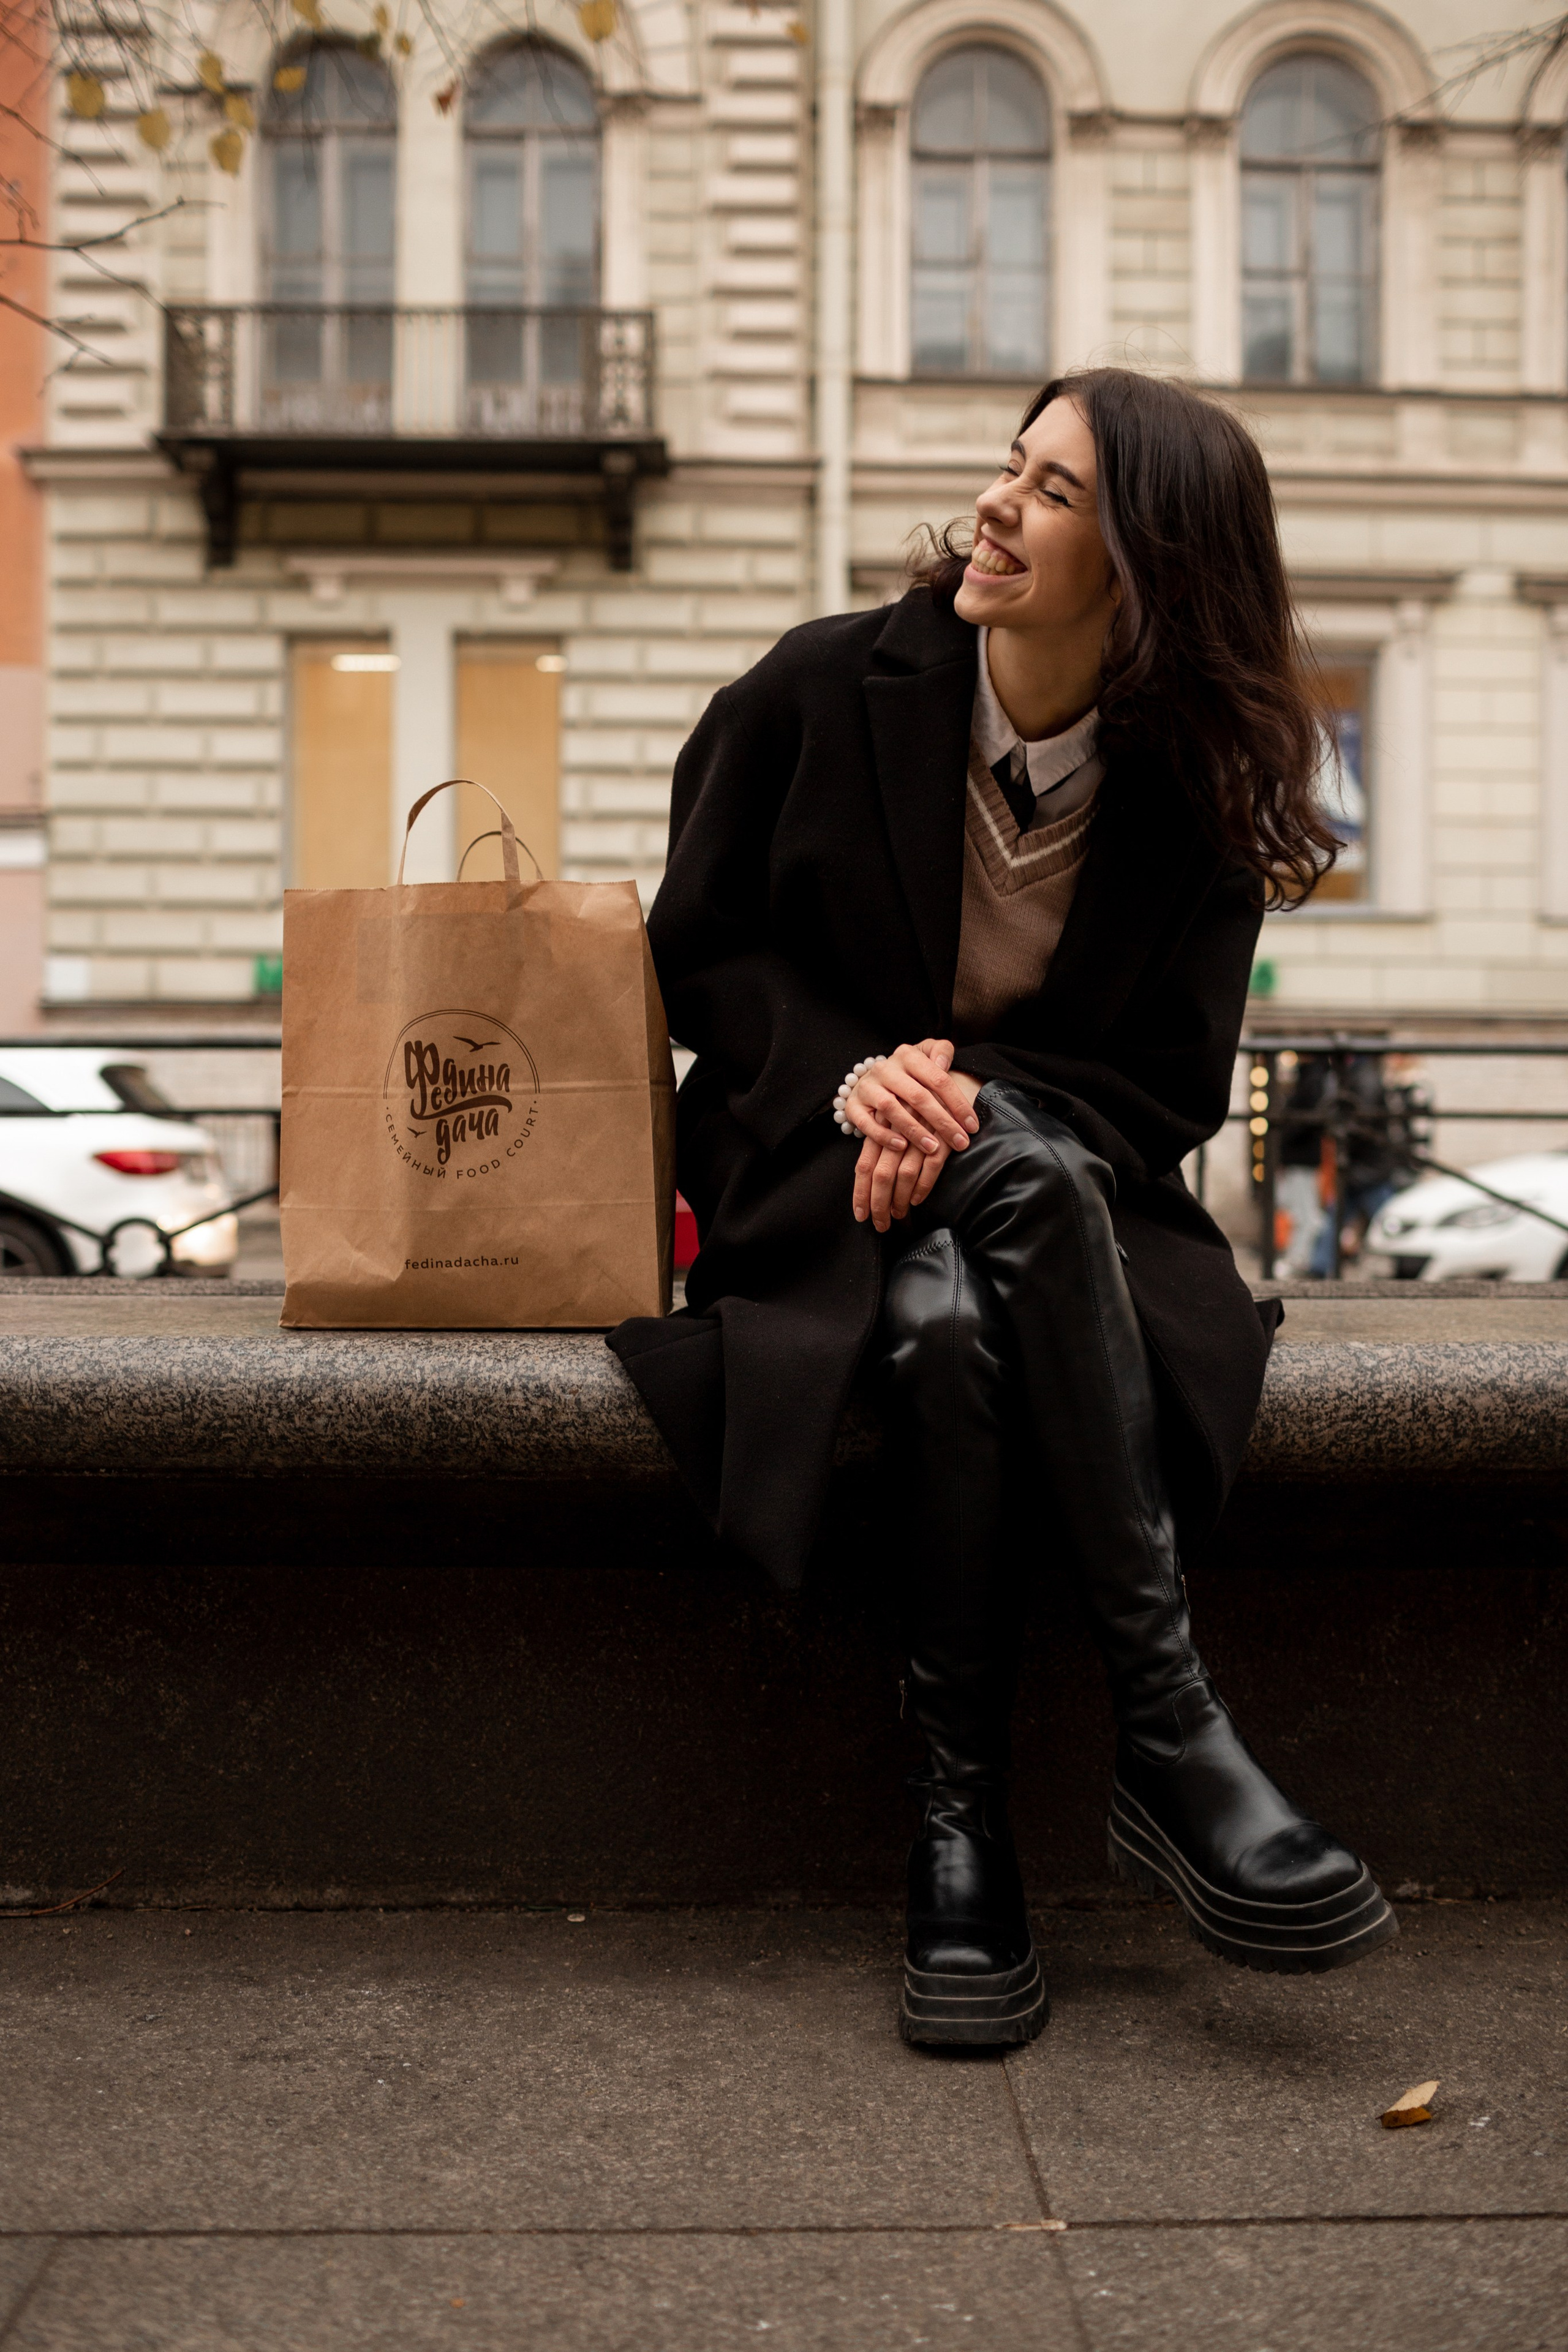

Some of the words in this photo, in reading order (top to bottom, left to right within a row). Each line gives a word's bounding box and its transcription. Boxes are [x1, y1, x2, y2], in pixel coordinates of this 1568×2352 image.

[404, 1039, 511, 1115] Федина
[385, 1114, 447, 1179] СЕМЕЙНЫЙ
[456, 1158, 501, 1180] FOOD
[507, 1107, 540, 1158] COURT
[435, 1107, 499, 1165] дача
[404, 1255, 519, 1270] fedinadacha.ru
